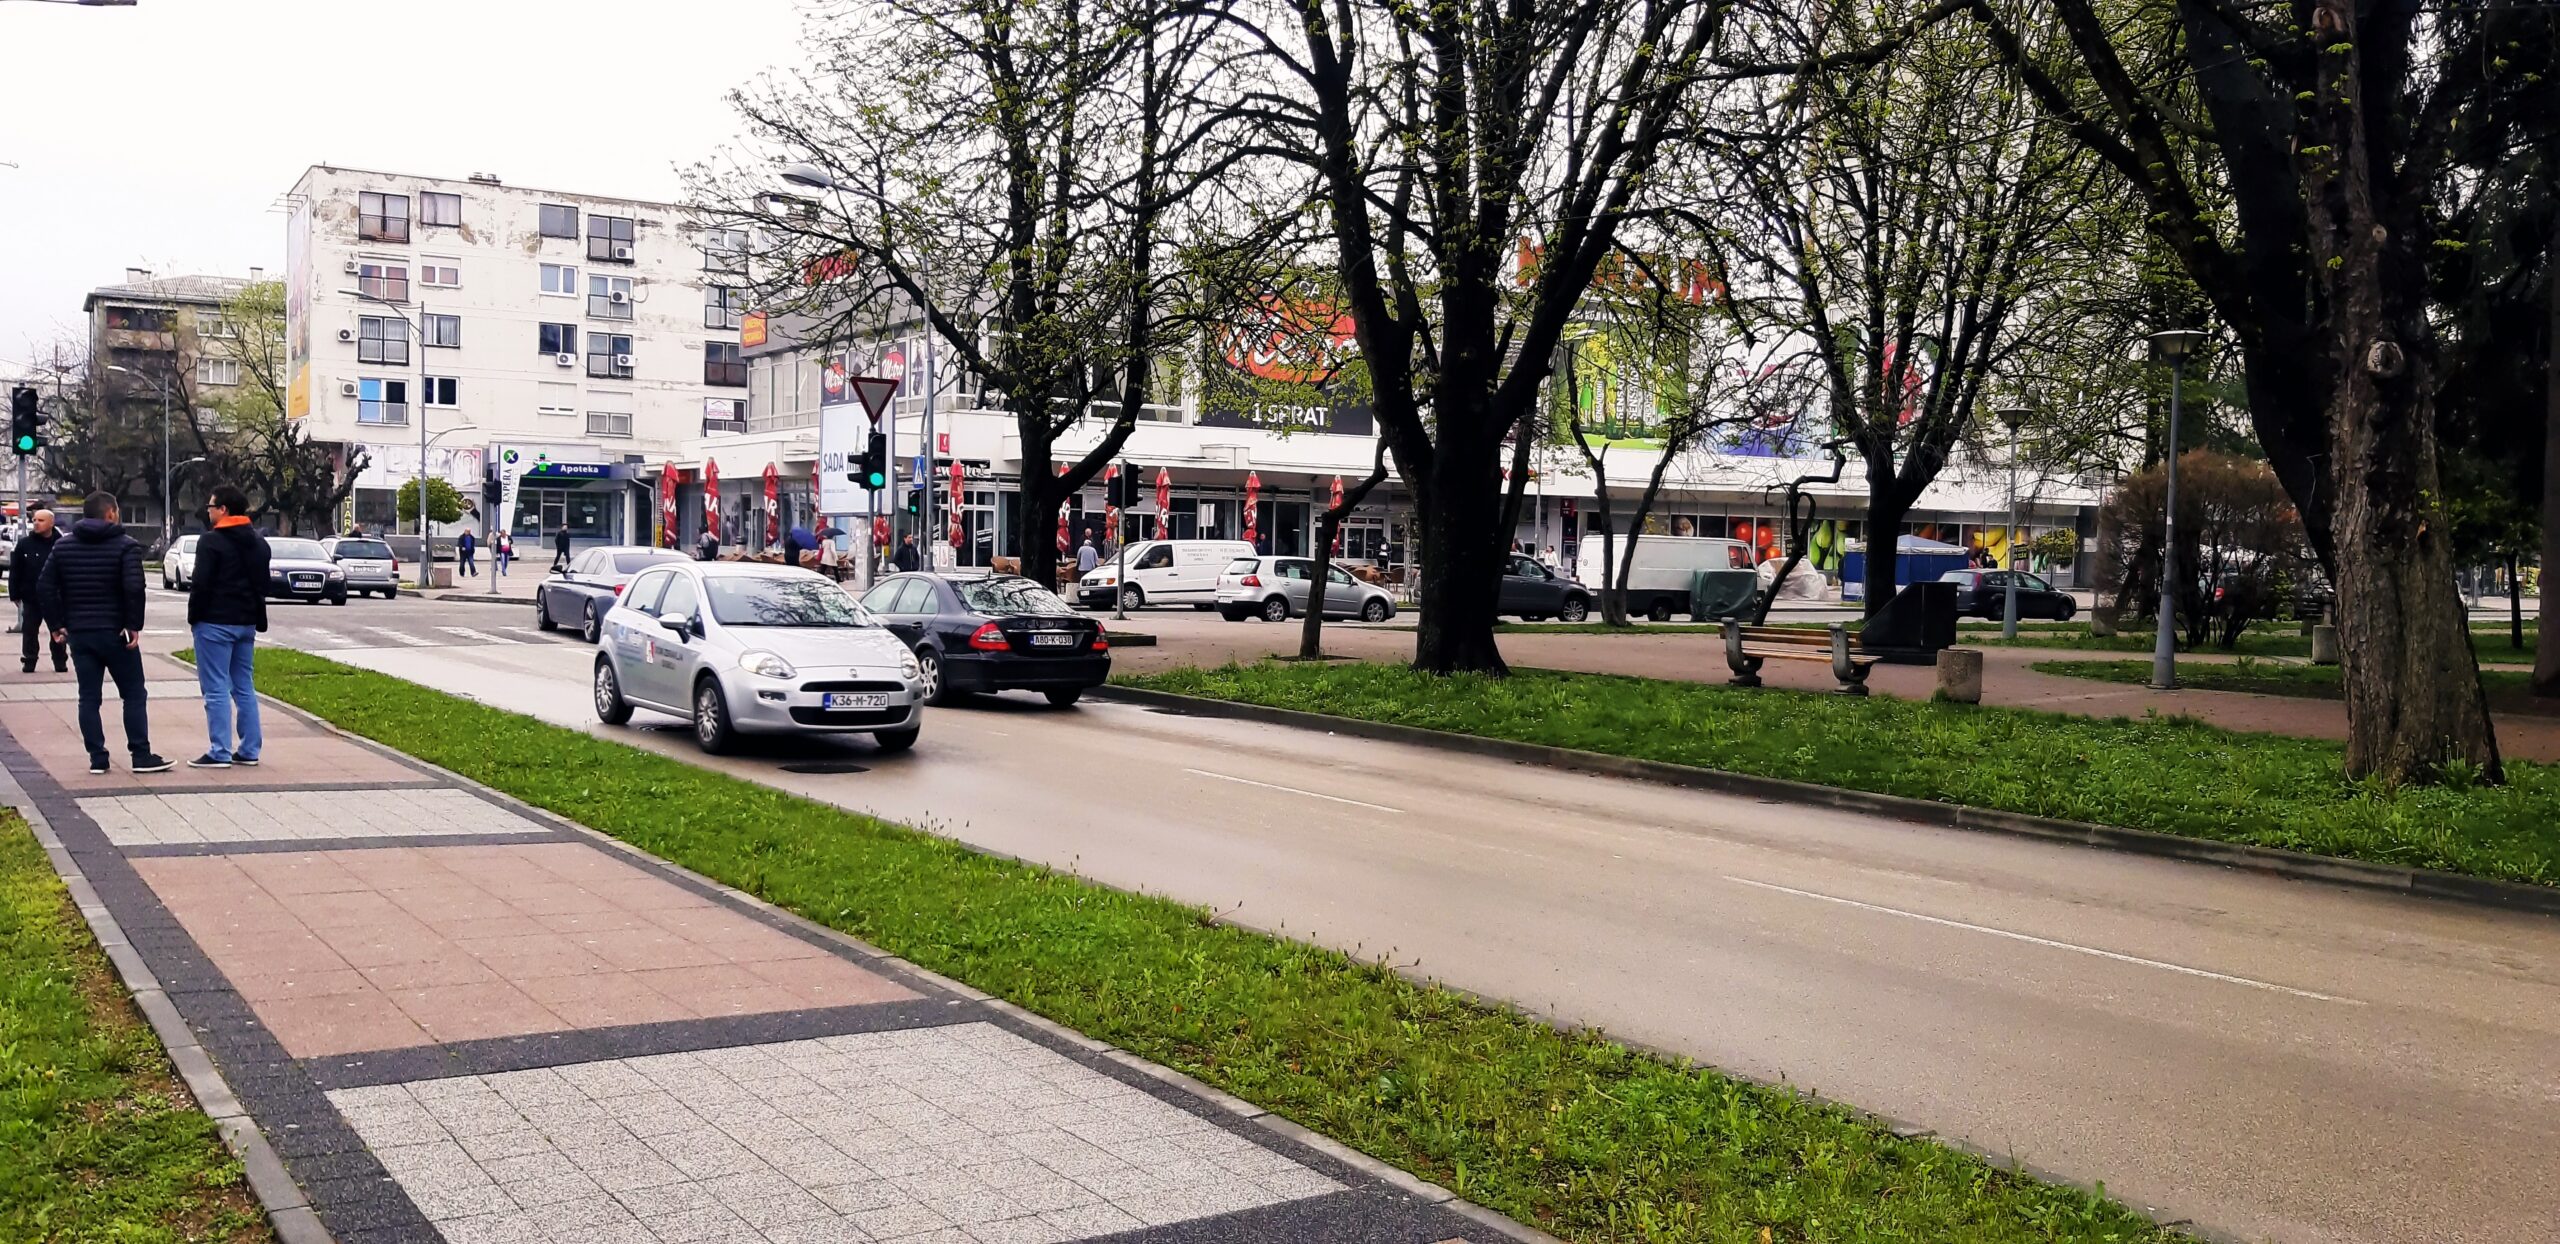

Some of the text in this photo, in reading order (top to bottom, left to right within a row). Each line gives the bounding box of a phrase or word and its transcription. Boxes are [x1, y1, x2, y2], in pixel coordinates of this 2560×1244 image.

[1252, 403, 1262, 422] 1
[560, 464, 599, 474] Apoteka
[823, 452, 844, 473] SADA
[502, 468, 512, 503] EXPERA
[832, 695, 886, 706] K36-M-720
